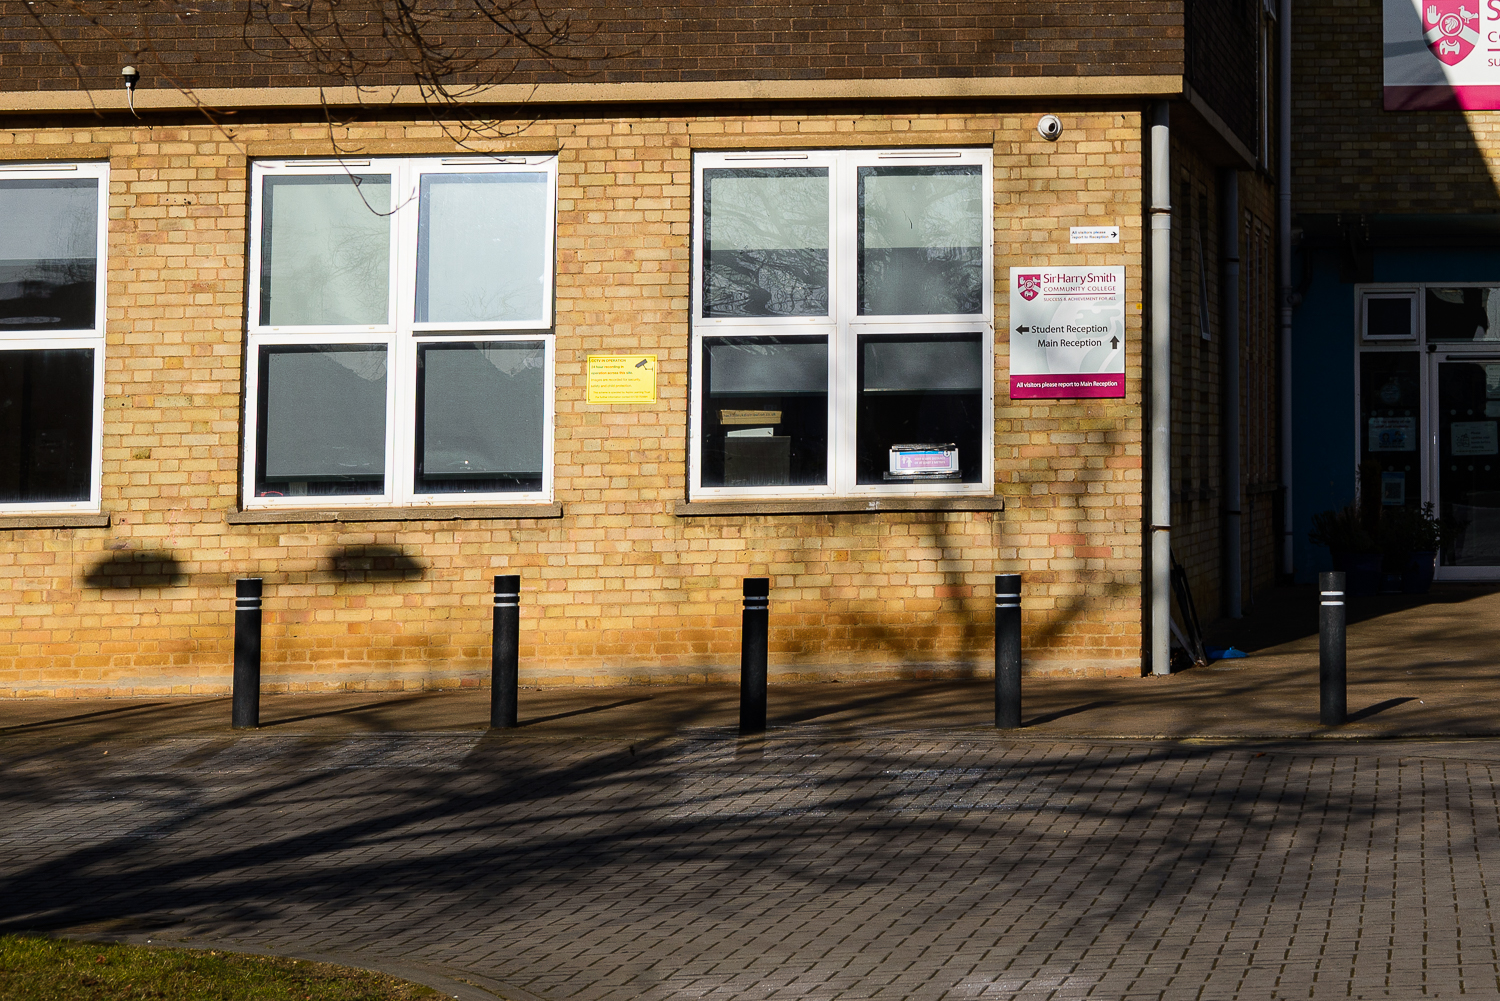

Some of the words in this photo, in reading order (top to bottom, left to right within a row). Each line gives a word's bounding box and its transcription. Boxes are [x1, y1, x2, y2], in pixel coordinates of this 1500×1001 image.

[1043, 273, 1056, 283] Sir
[1057, 273, 1086, 285] Harry
[1087, 272, 1116, 283] Smith
[1031, 325, 1065, 334] Student
[1066, 324, 1108, 334] Reception
[1037, 339, 1058, 347] Main
[1060, 338, 1102, 348] Reception
[1041, 381, 1058, 389] please
[1058, 381, 1073, 389] report
[1093, 380, 1118, 388] Reception
